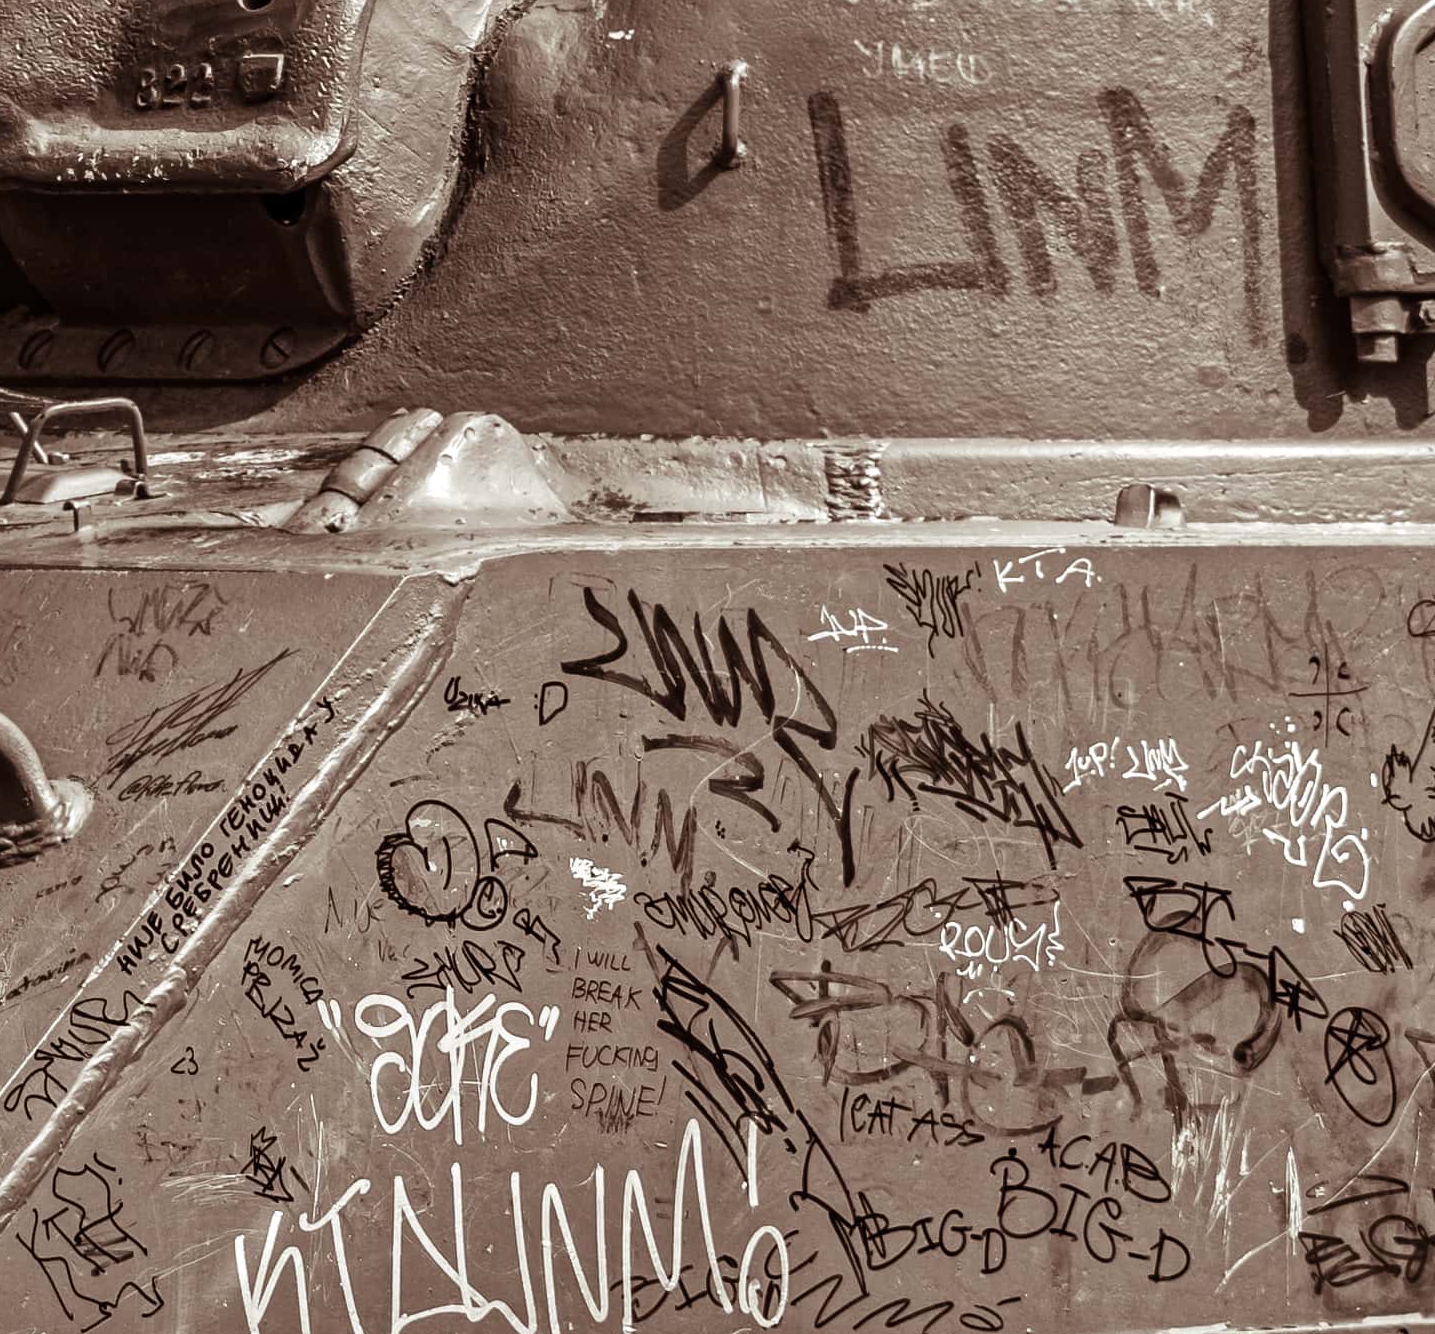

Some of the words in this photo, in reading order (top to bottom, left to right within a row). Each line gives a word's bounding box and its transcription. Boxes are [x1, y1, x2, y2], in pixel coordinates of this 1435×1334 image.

[587, 950, 631, 972] WILL
[571, 977, 643, 1011] BREAK
[573, 1010, 613, 1034] HER
[565, 1042, 660, 1073] FUCKING
[570, 1075, 668, 1119] SPINE!
